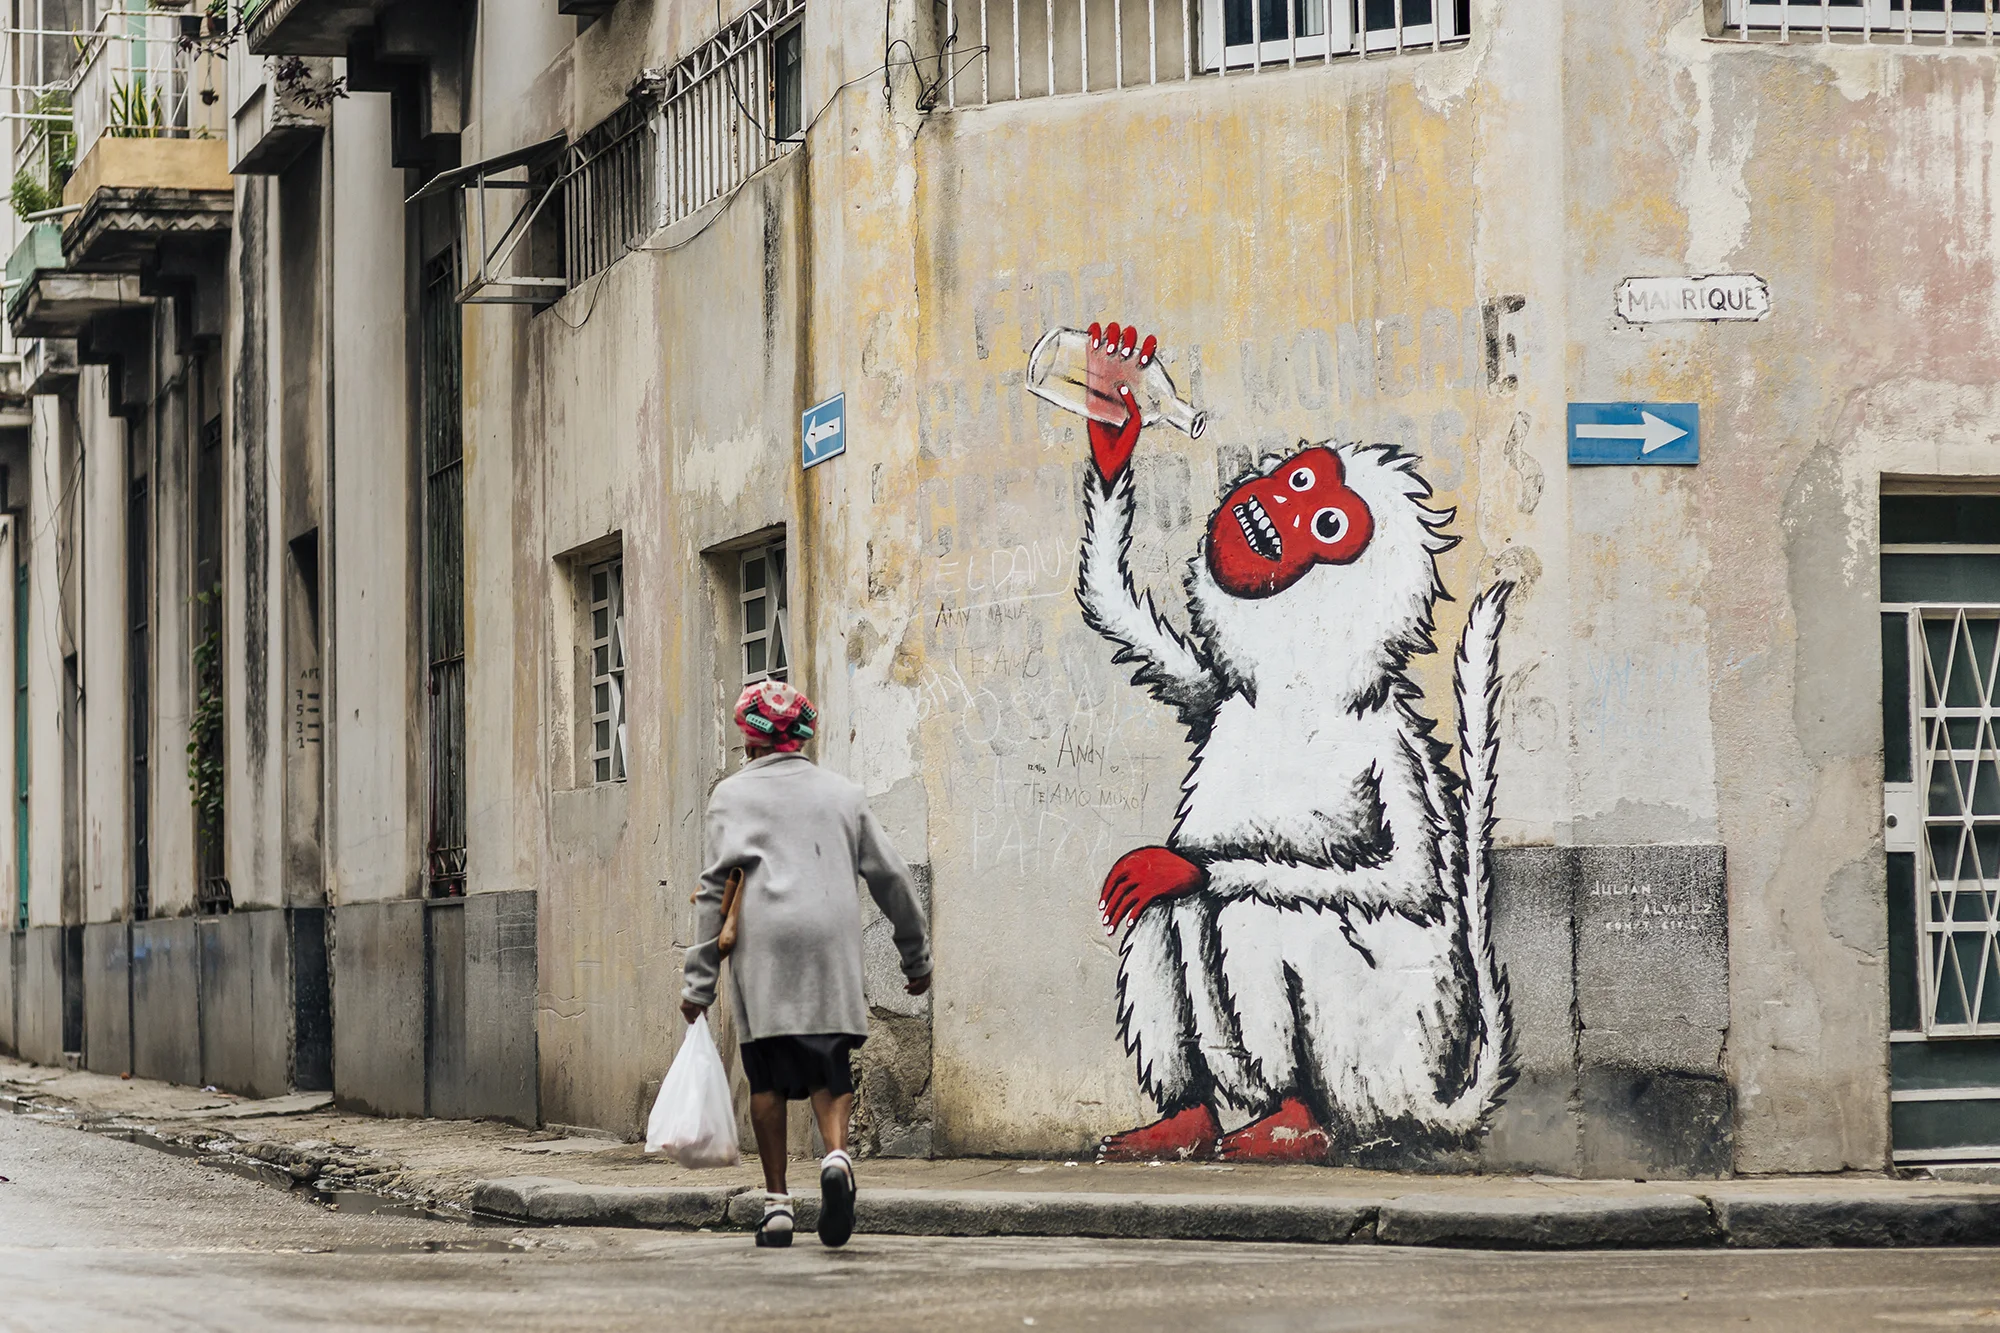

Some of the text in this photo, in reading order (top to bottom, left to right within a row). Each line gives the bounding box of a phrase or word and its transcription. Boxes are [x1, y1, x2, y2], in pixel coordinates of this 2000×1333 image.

[1627, 287, 1758, 312] MANRIQUE
[296, 704, 304, 717] 5
[296, 721, 303, 733] 3
[1590, 879, 1651, 896] JULIAN
